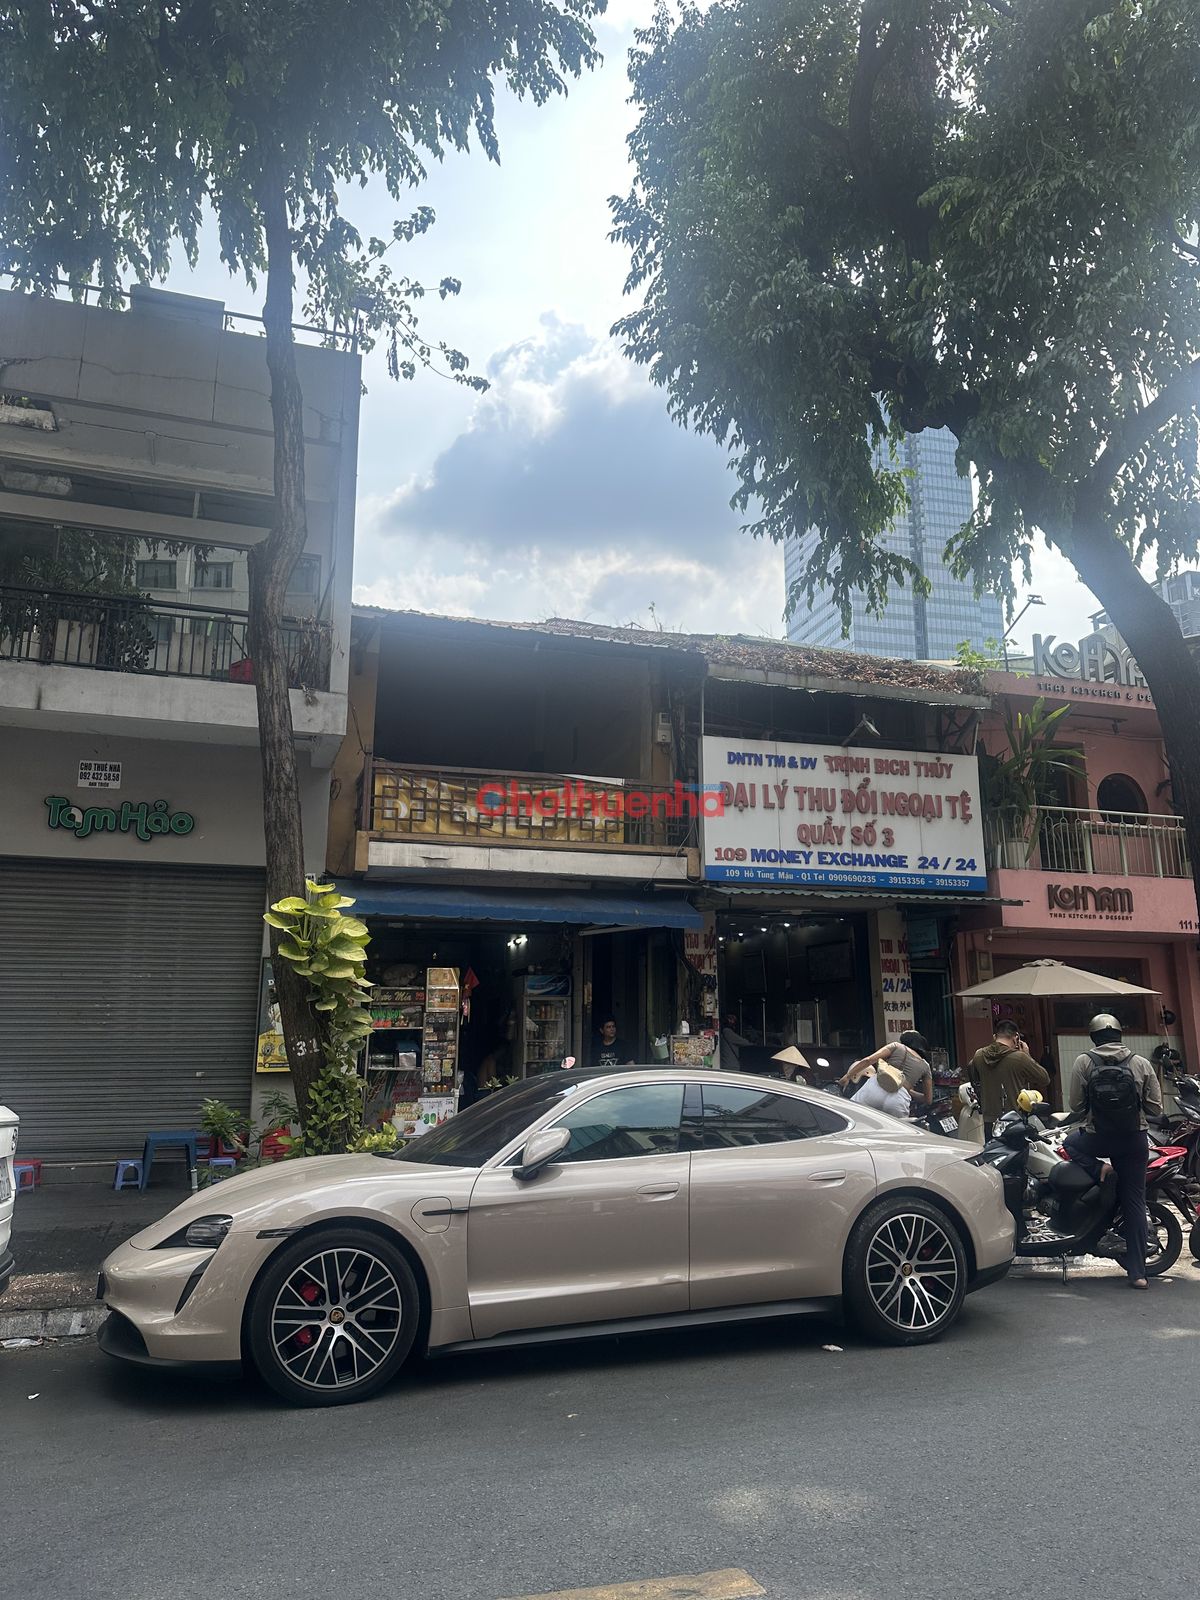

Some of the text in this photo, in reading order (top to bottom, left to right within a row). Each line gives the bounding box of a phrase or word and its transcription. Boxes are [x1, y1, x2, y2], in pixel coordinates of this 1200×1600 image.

[727, 751, 763, 767] DNTN
[765, 754, 785, 768] TM
[787, 755, 799, 769] &
[800, 757, 818, 770] DV
[823, 755, 870, 777] TRỊNH
[762, 779, 789, 810] LÝ
[793, 785, 837, 813] THU
[840, 777, 878, 815] ĐỔI
[880, 791, 943, 823] NGOẠI
[945, 789, 973, 825] TỆ
[119, 799, 195, 842] Hảo
[851, 819, 878, 847] SỐ
[881, 827, 895, 848] 3
[714, 847, 748, 861] 109
[750, 848, 814, 865] MONEY
[817, 851, 908, 869] EXCHANGE
[918, 855, 940, 870] 24
[955, 857, 977, 871] 24
[725, 869, 740, 877] 109
[801, 872, 811, 882] Q1
[813, 872, 825, 881] Tel
[828, 873, 877, 884] 0909690235
[888, 876, 926, 886] 39153356
[935, 878, 970, 887] 39153357
[1178, 919, 1193, 930] 111
